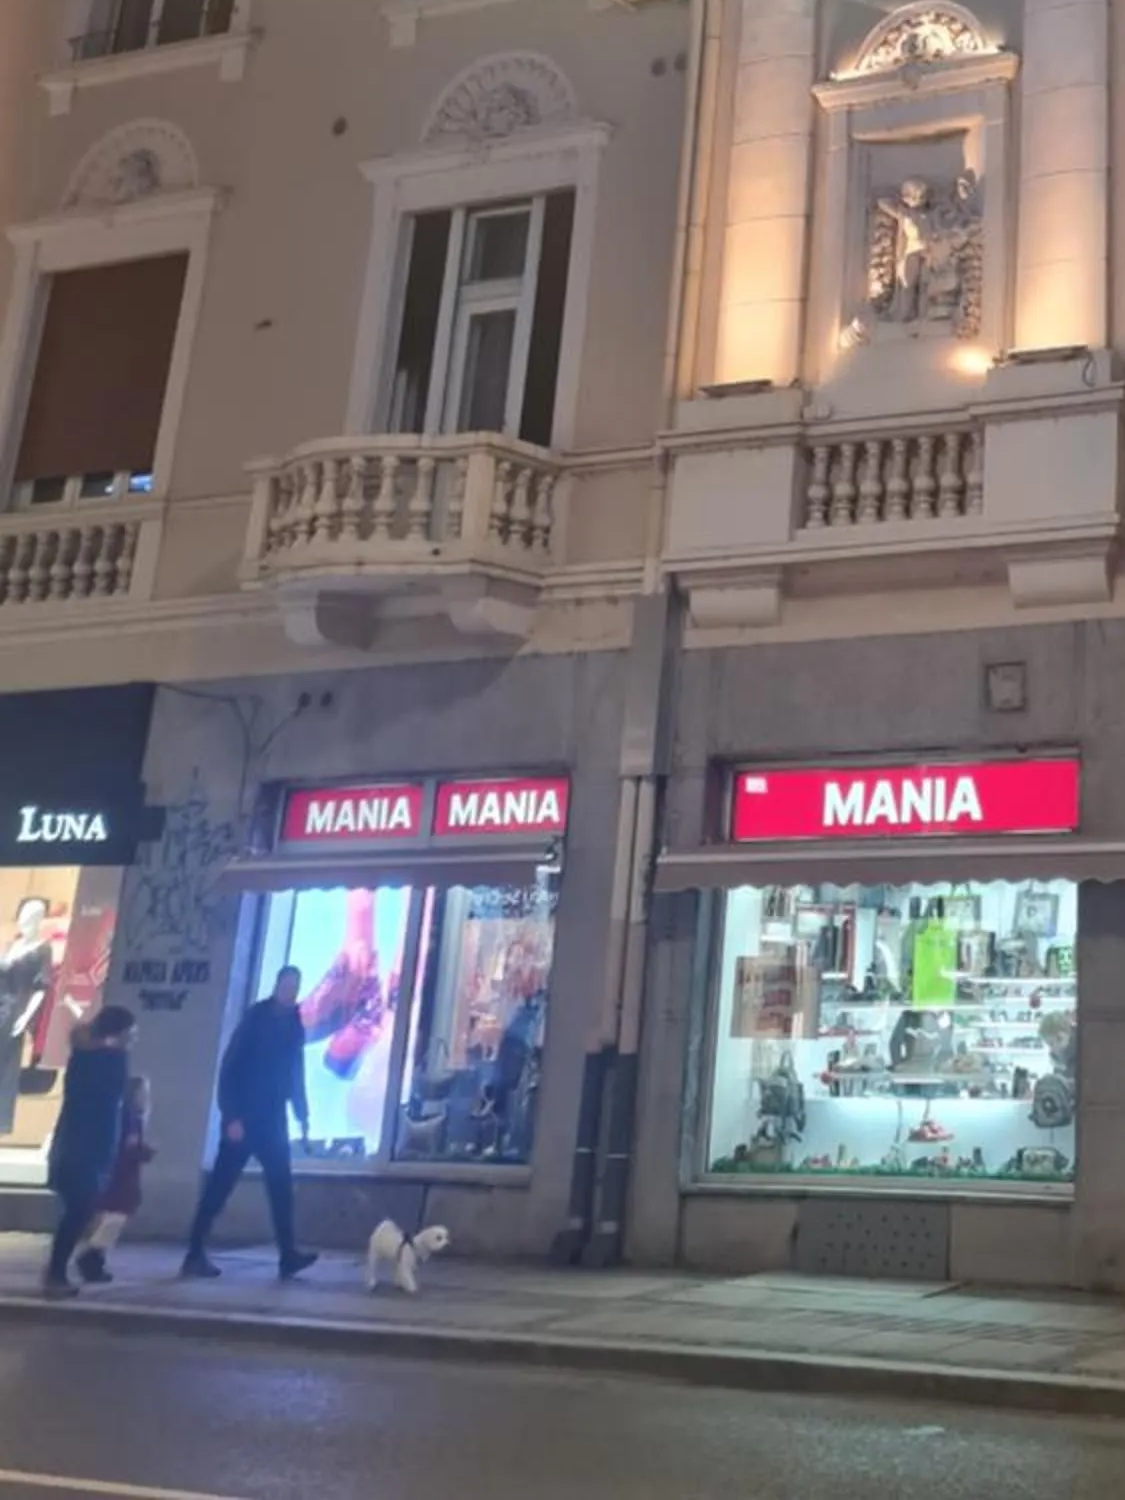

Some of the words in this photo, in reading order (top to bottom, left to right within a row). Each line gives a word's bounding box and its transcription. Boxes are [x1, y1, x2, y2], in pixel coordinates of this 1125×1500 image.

[304, 795, 413, 835] MANIA
[447, 788, 561, 827] MANIA
[822, 775, 983, 827] MANIA
